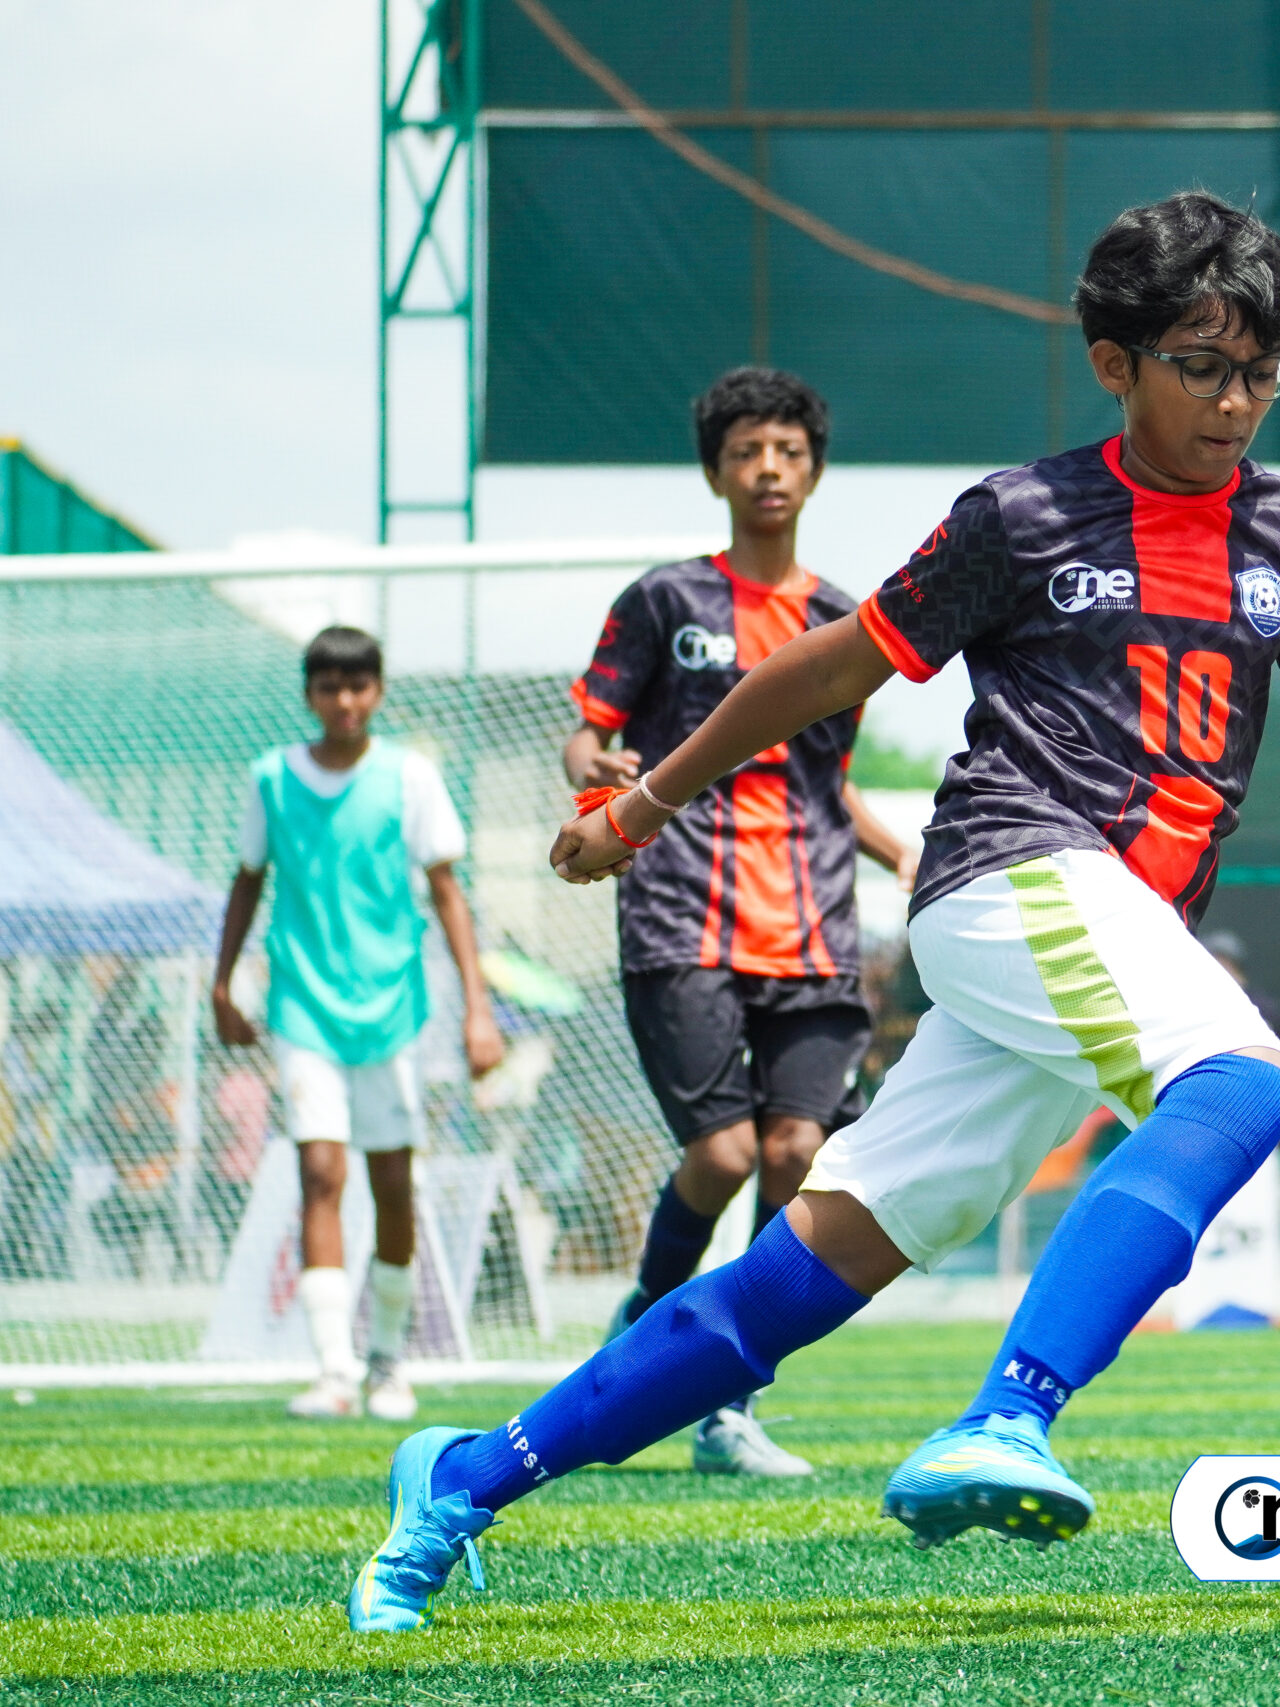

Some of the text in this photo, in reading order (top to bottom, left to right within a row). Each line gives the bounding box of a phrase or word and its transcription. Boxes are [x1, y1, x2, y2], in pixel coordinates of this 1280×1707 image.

[898, 567, 925, 603] ports
[1048, 563, 1135, 612] One
[1126, 643, 1233, 763] 10
